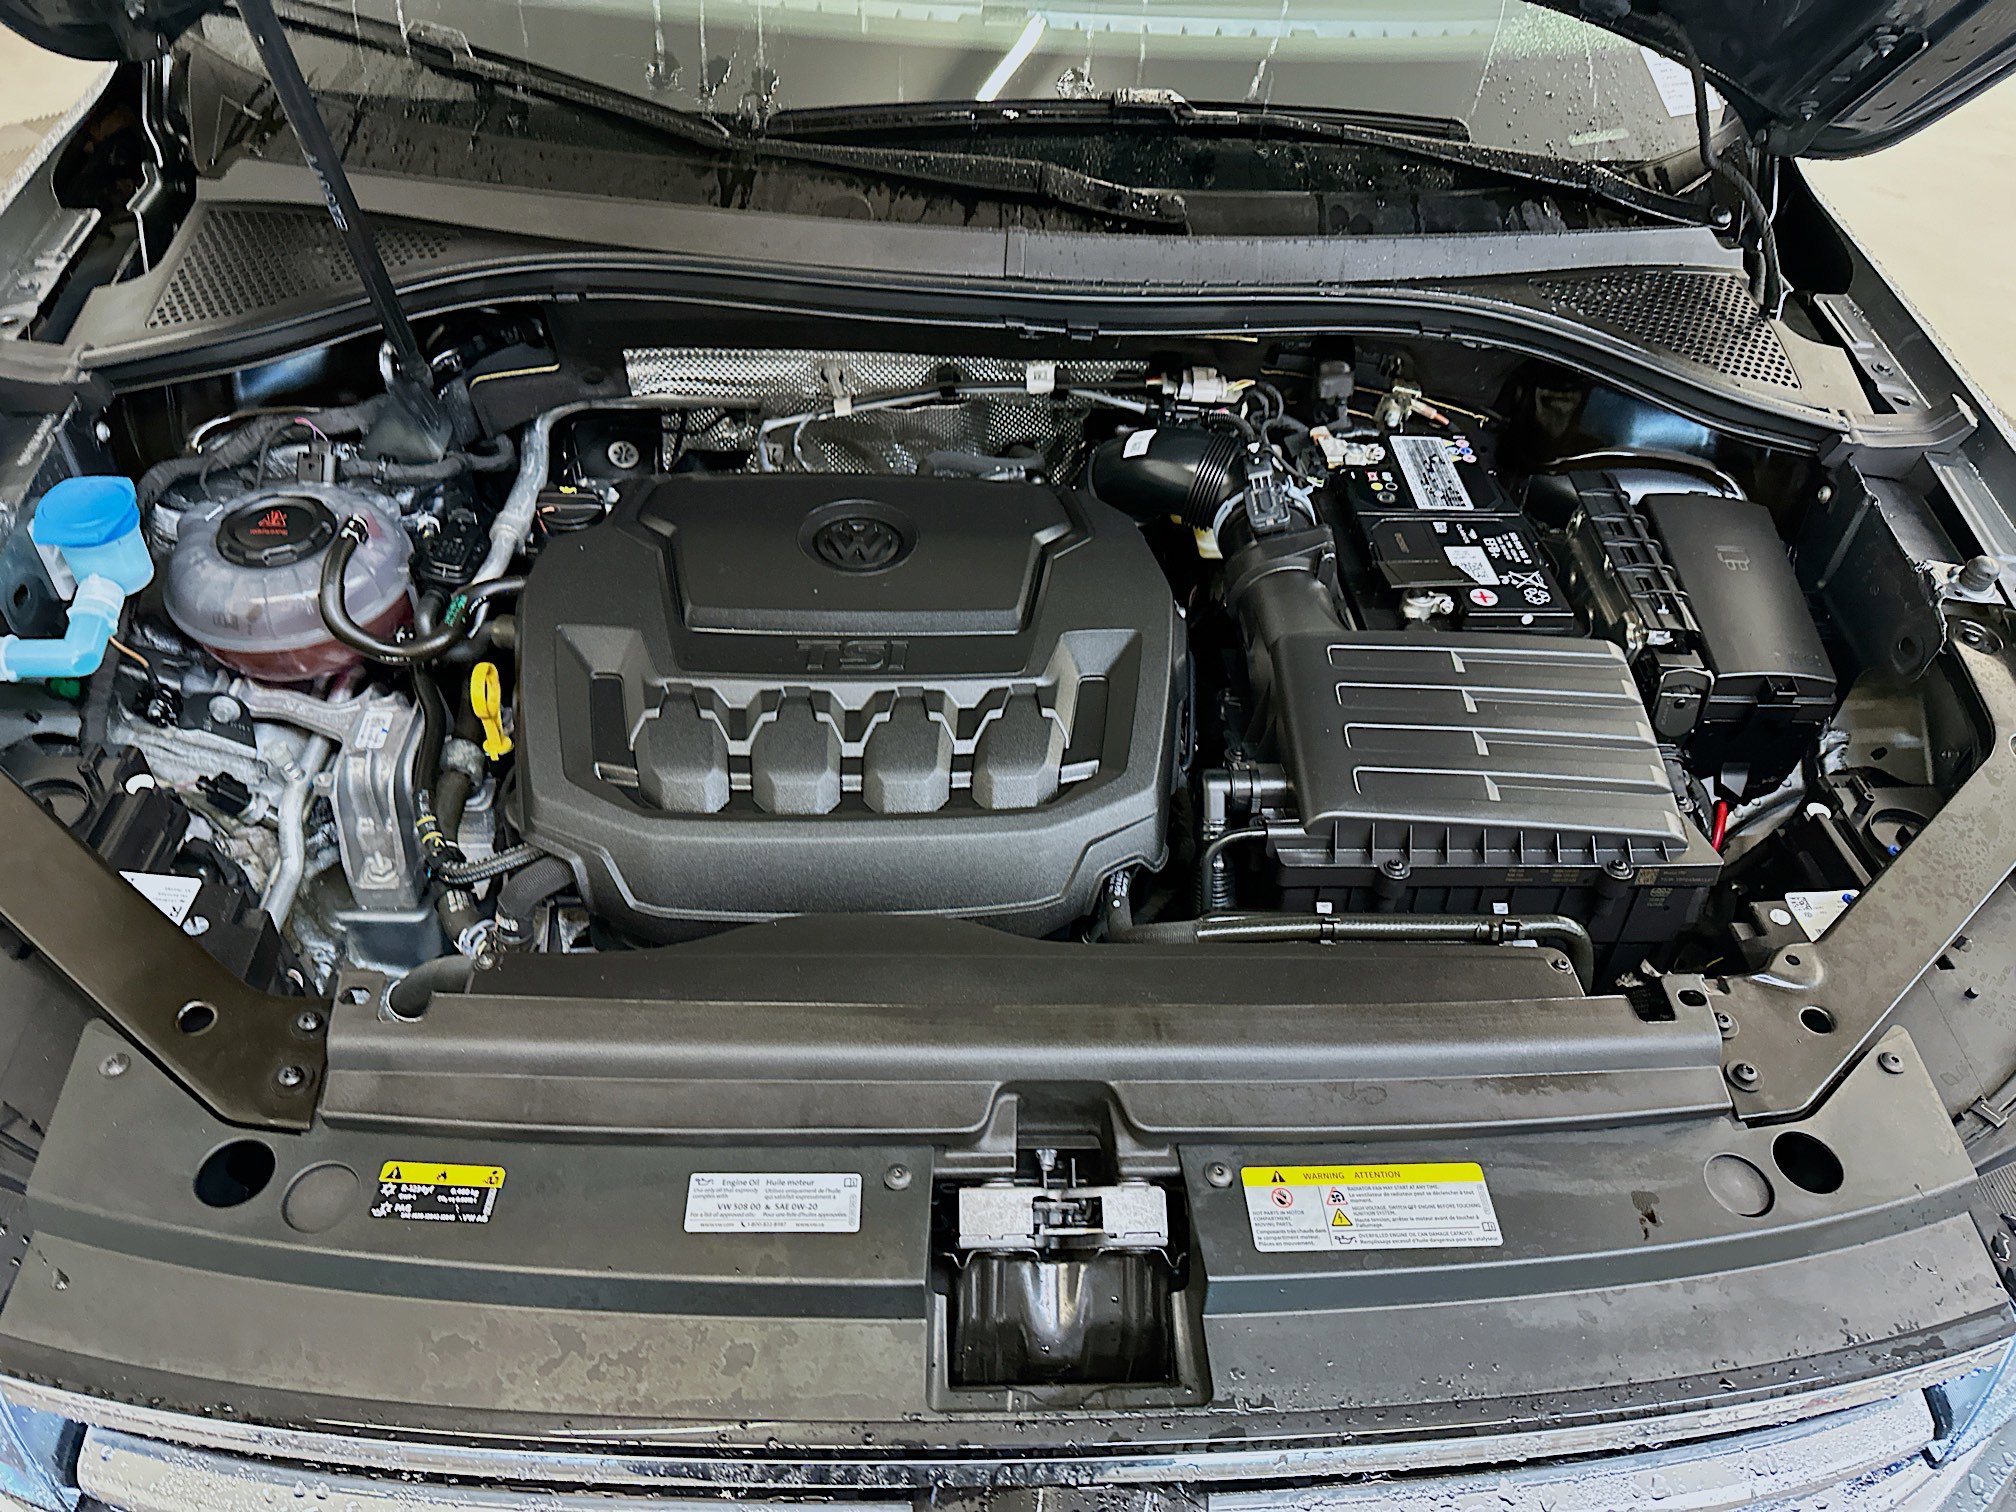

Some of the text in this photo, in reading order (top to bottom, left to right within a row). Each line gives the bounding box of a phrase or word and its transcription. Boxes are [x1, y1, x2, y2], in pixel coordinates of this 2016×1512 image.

[818, 519, 899, 568] VW
[796, 639, 909, 672] TSI
[1303, 1170, 1401, 1180] WARNING ATTENTION
[722, 1178, 760, 1188] Engine Oil
[766, 1178, 786, 1186] Huile
[717, 1203, 732, 1211] VW
[733, 1203, 748, 1211] 508
[750, 1203, 761, 1211] 00
[775, 1203, 789, 1211] SAE
[791, 1203, 819, 1211] 0W-20
